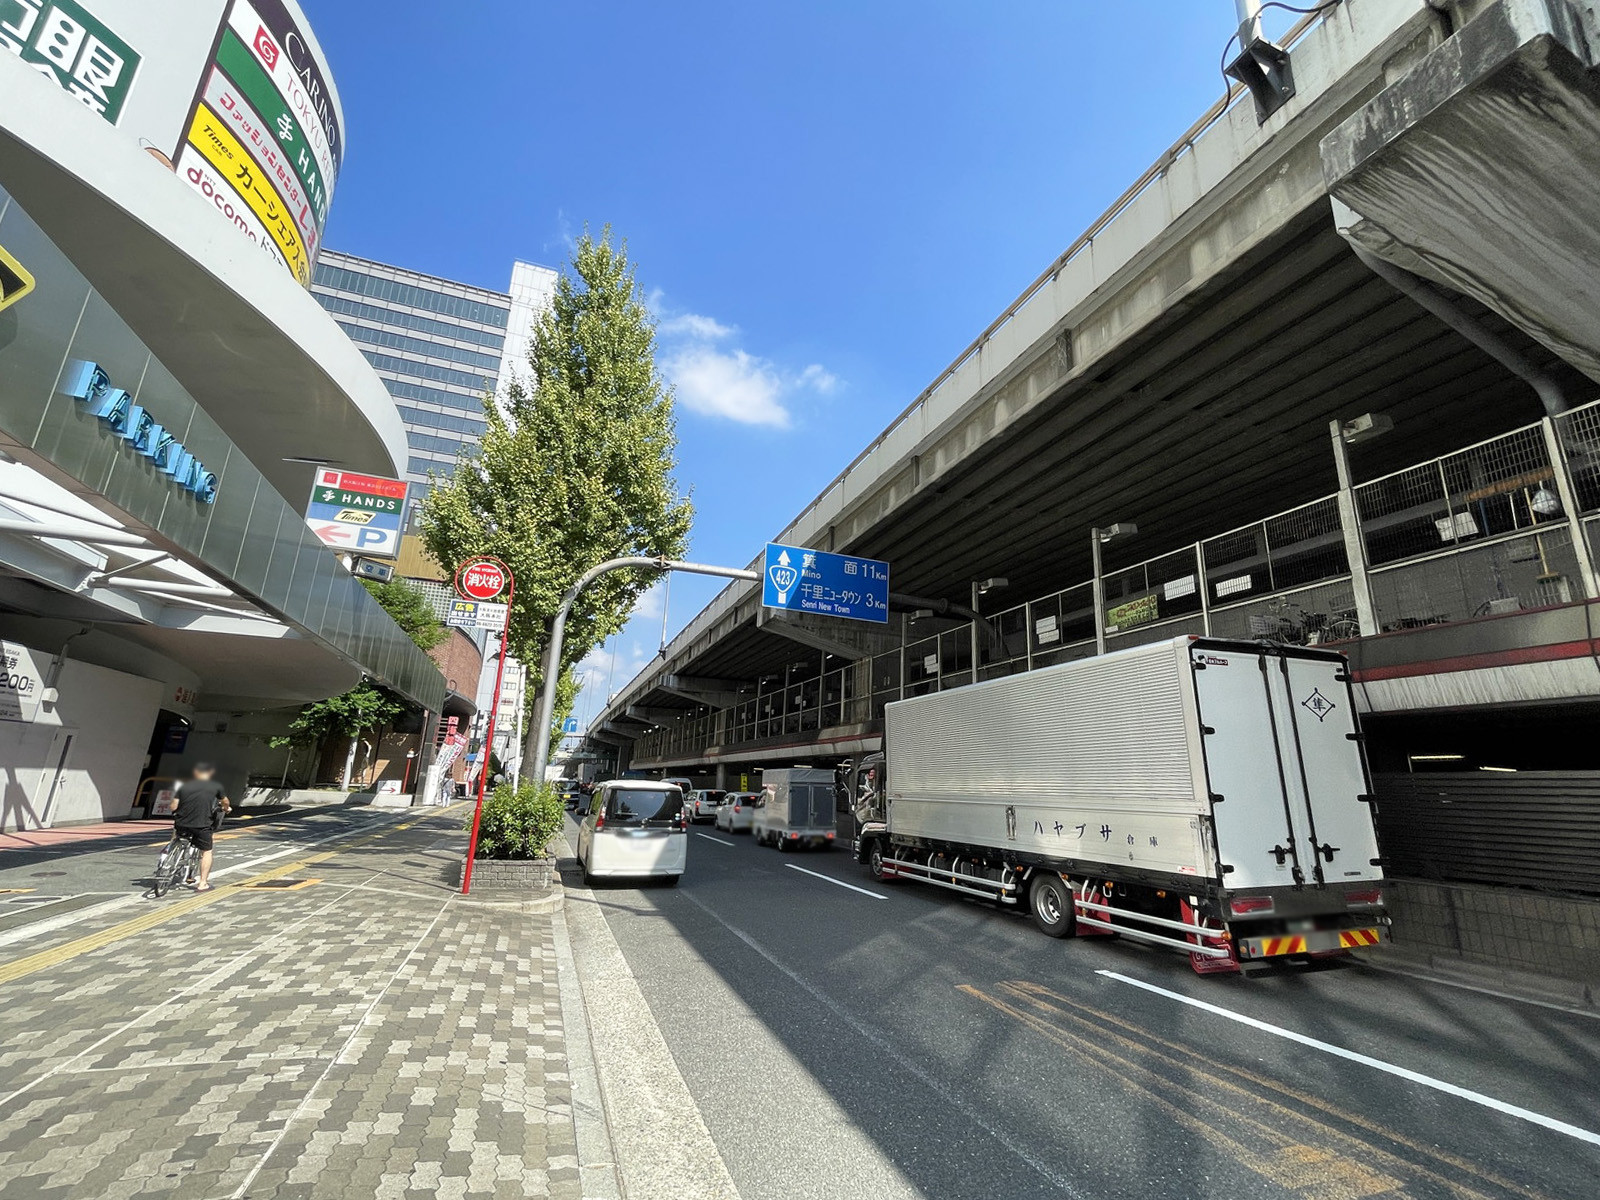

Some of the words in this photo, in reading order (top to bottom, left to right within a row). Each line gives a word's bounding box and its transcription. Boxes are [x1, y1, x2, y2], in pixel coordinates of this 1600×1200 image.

[285, 31, 336, 147] CARINO
[287, 71, 323, 149] TOKYU
[203, 125, 234, 160] Times
[66, 359, 217, 504] PARKING
[341, 494, 396, 511] HANDS
[341, 513, 369, 523] Times
[356, 528, 388, 548] P
[467, 573, 501, 589] 消火栓
[775, 569, 791, 586] 423
[801, 569, 821, 580] Mino
[801, 583, 861, 605] 千里ニュータウン
[801, 599, 818, 609] Senri
[819, 601, 832, 611] New
[834, 603, 850, 614] Town
